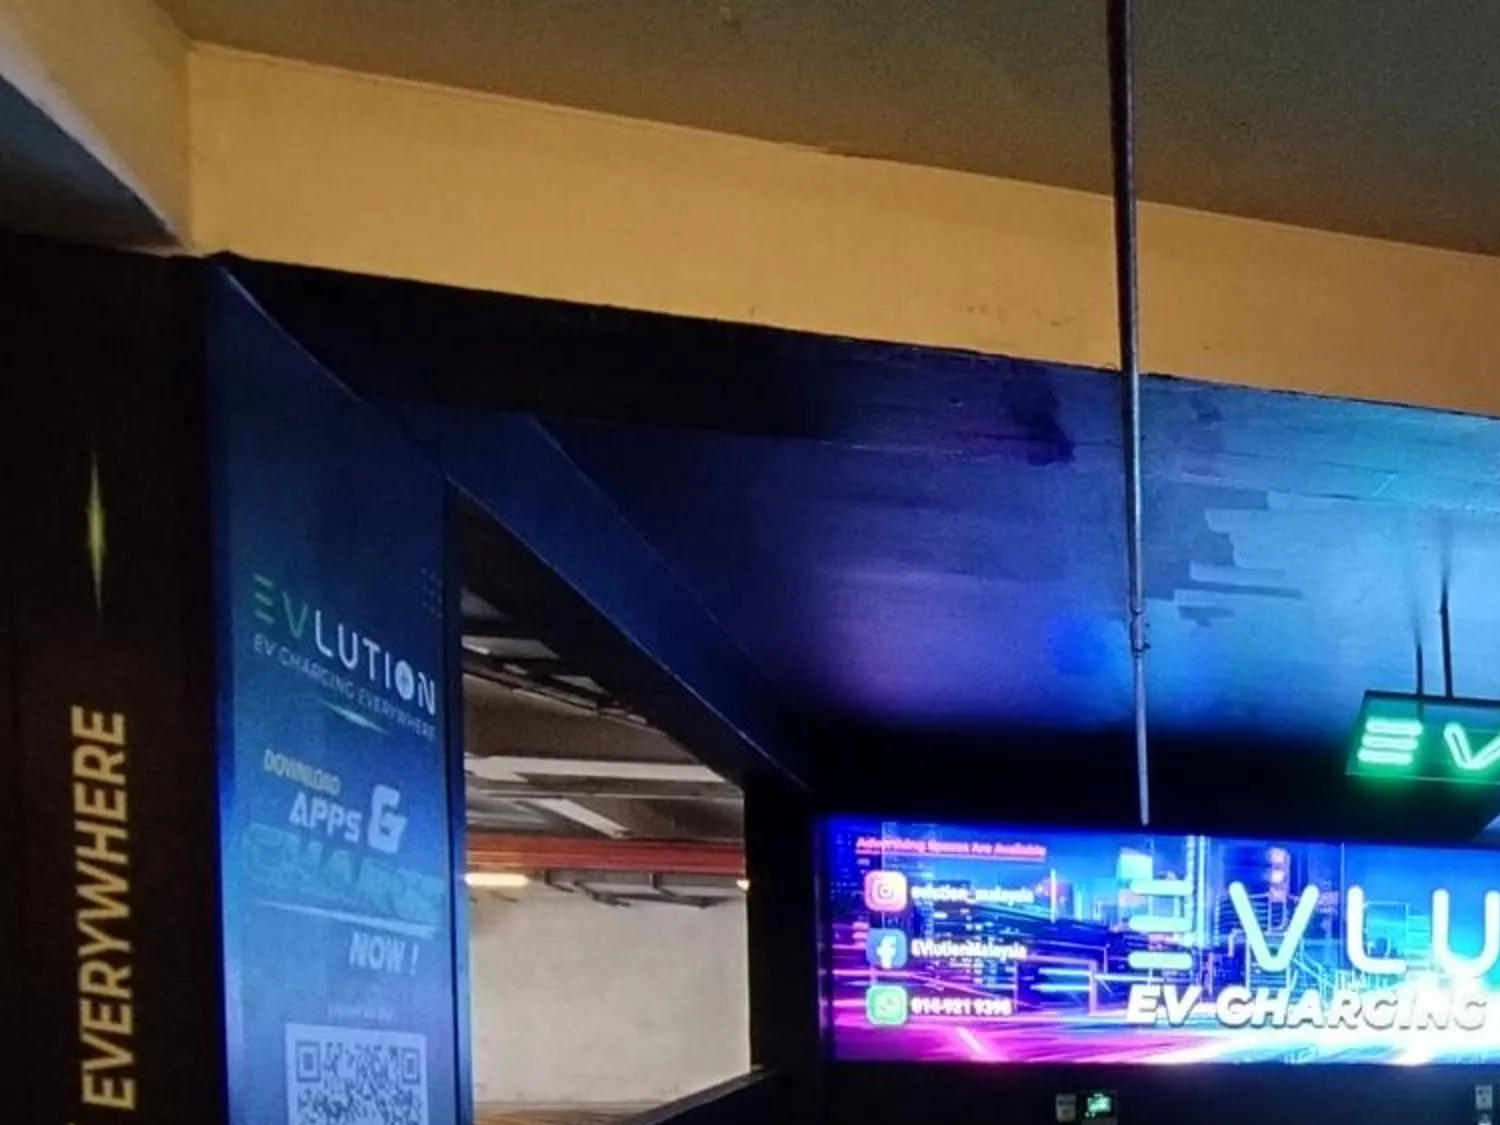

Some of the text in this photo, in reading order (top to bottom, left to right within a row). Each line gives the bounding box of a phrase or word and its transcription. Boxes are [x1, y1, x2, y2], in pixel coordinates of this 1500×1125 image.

[253, 574, 437, 714] EVLUTION
[289, 790, 362, 844] APPS
[72, 705, 135, 1109] EVERYWHERE
[349, 929, 405, 974] NOW
[1126, 984, 1197, 1030] EV
[1215, 985, 1488, 1031] CHARGING
